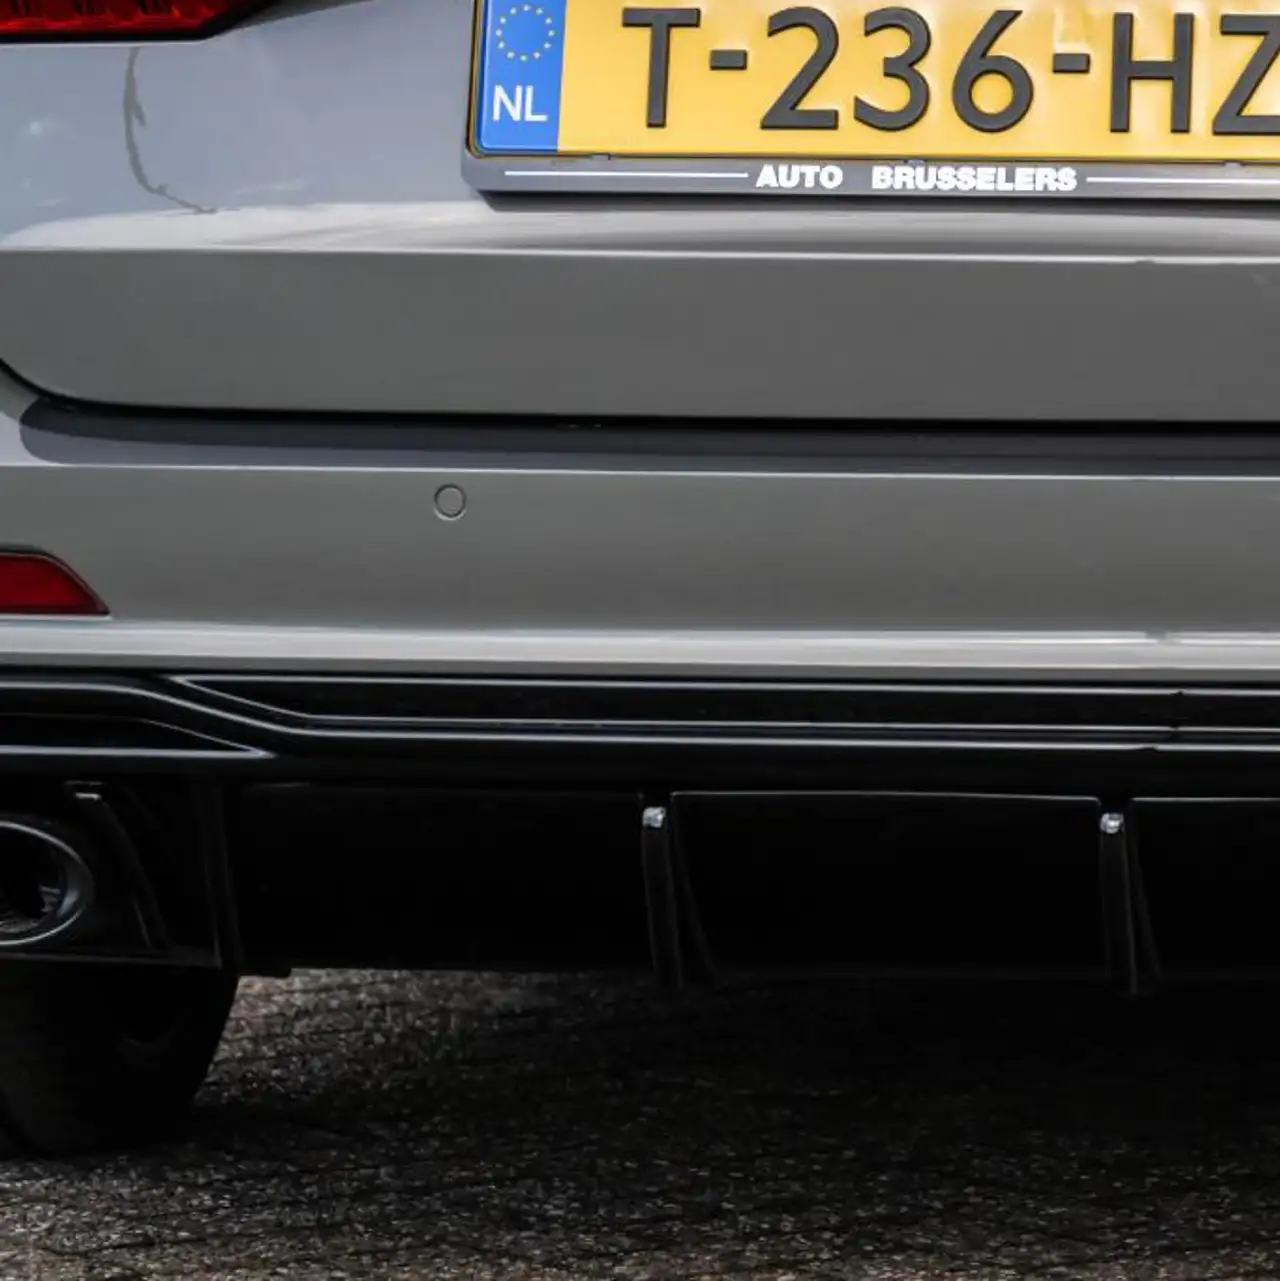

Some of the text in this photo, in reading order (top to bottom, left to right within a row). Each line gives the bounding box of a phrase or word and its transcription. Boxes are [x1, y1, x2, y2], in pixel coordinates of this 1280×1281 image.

[492, 85, 548, 123] NL
[755, 165, 1078, 193] AUTO BRUSSELERS
